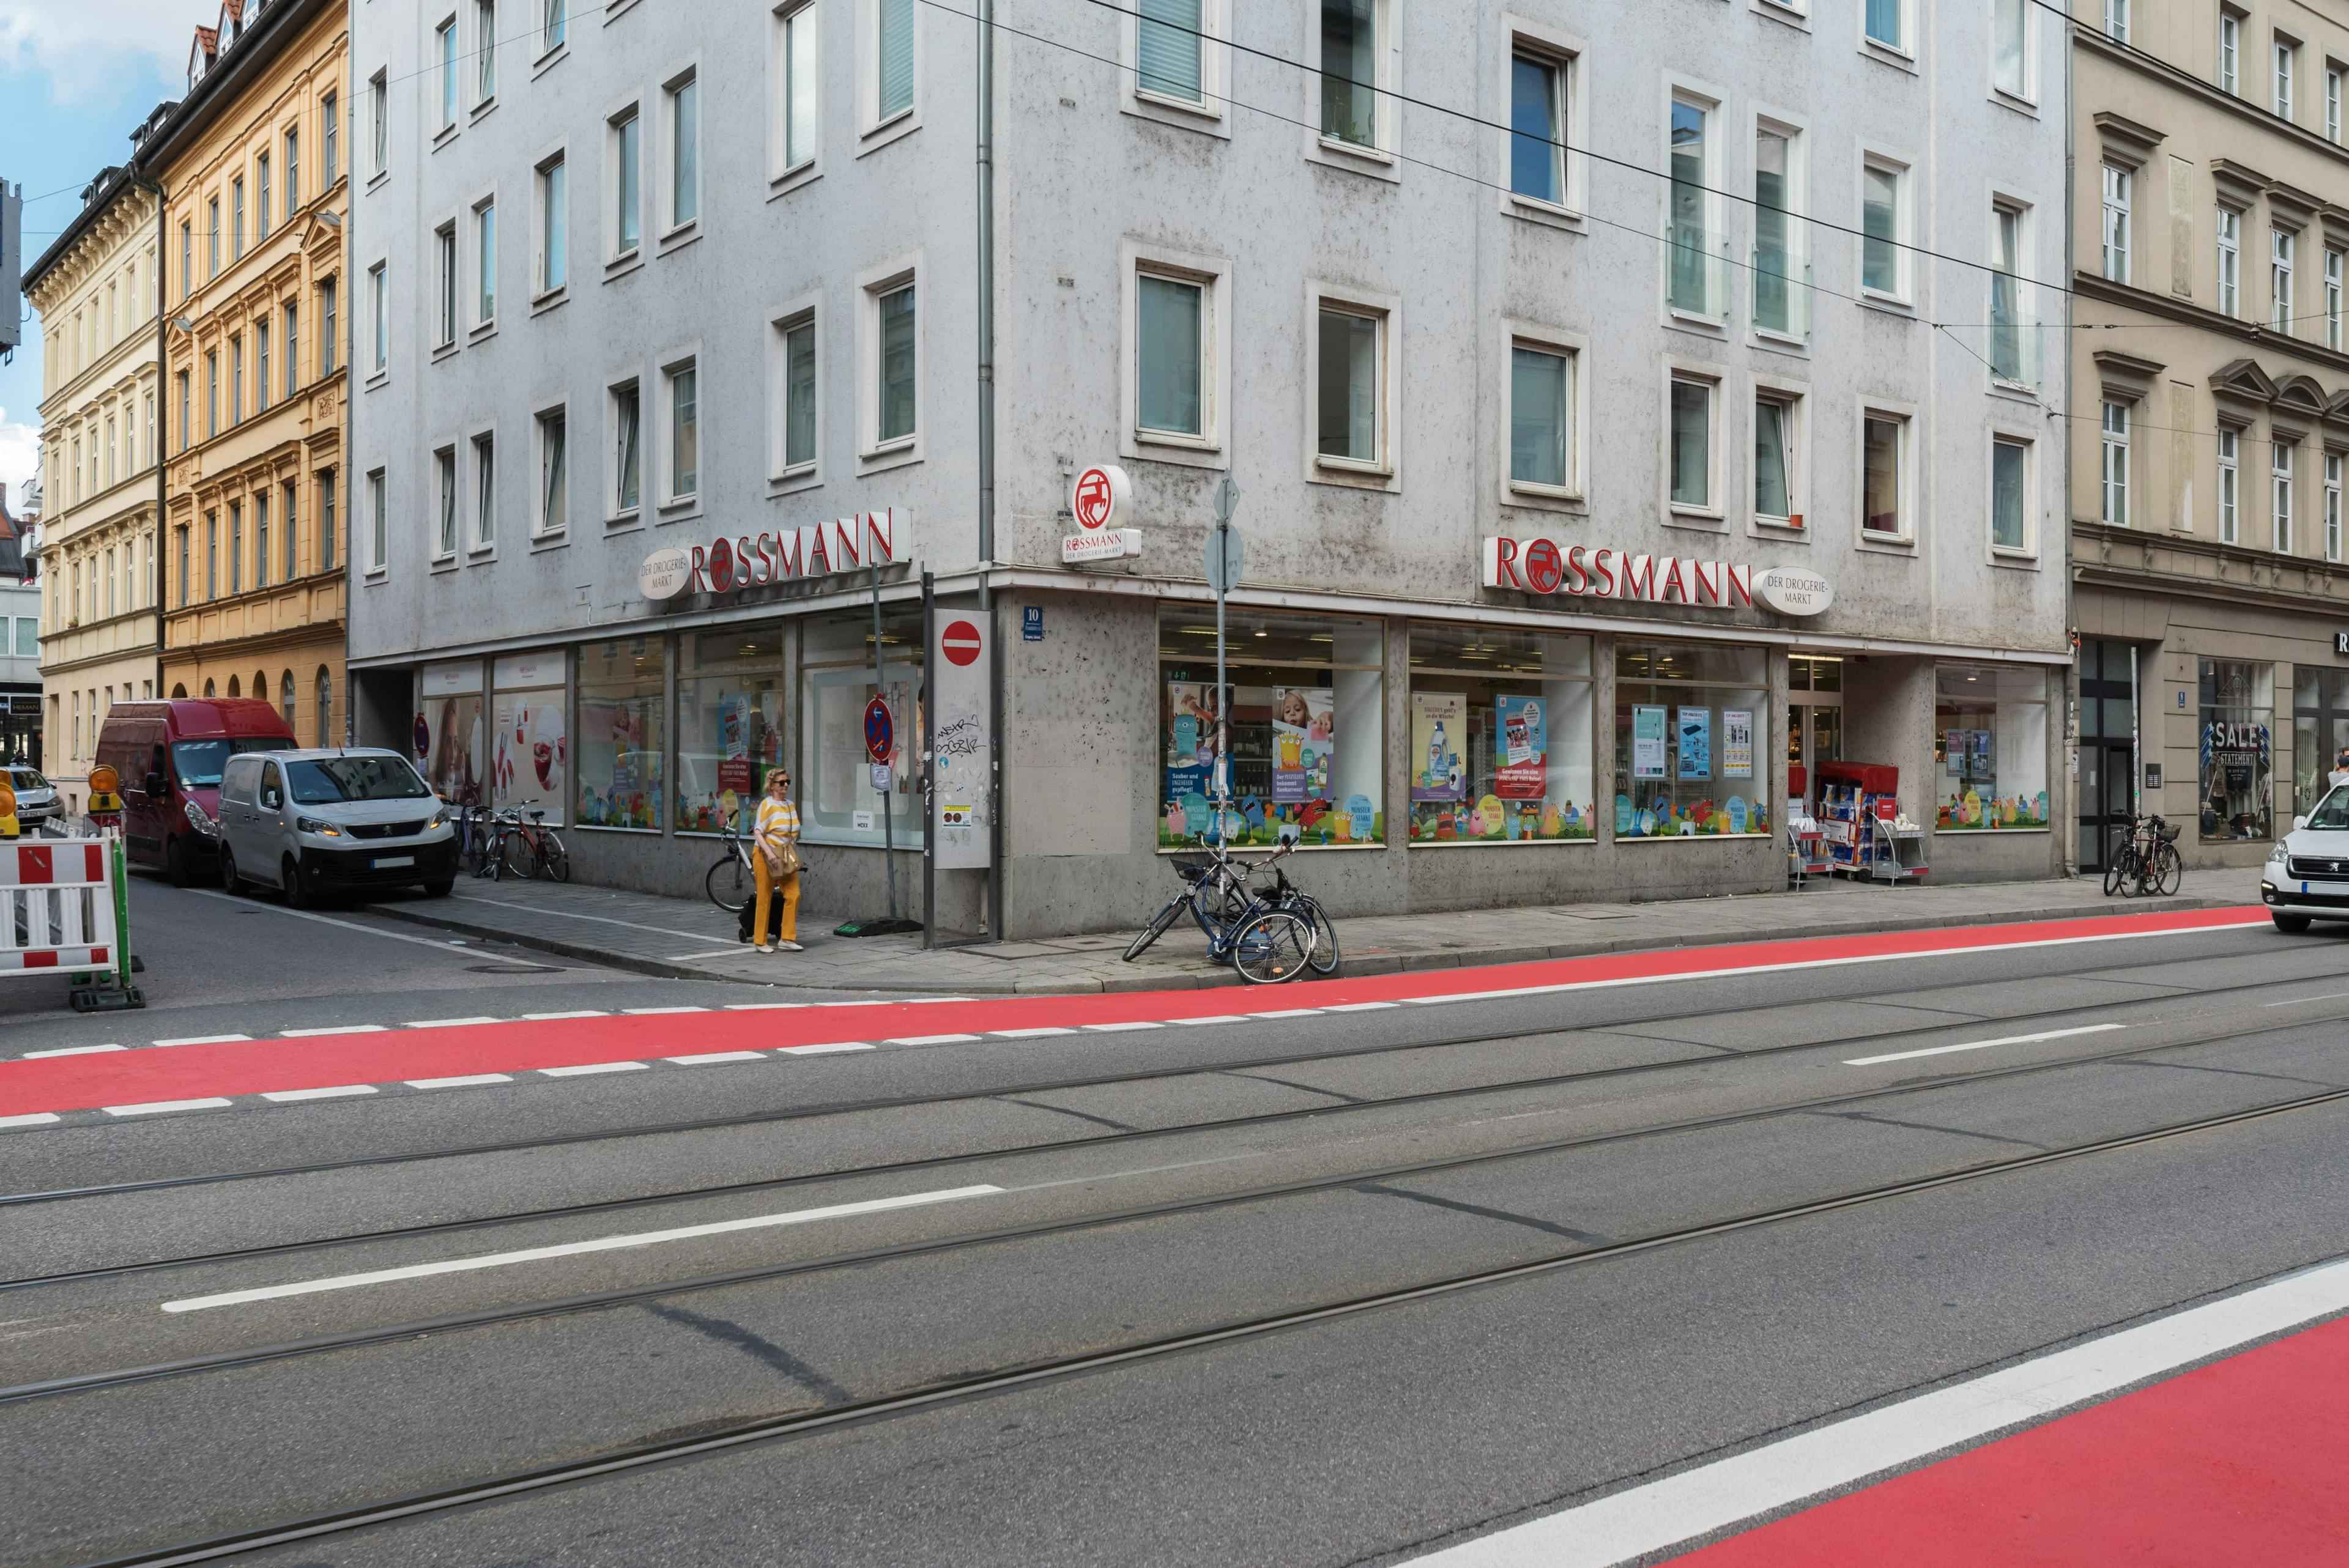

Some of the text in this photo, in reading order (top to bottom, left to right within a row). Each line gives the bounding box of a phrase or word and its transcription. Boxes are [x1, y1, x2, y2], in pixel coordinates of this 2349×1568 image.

[691, 507, 892, 594] ROSSMANN
[1066, 533, 1121, 551] ROSSMANN
[640, 557, 686, 577] DER DROGERIE-
[1497, 537, 1751, 607] ROSSMANN
[651, 574, 672, 588] MARKT
[1768, 576, 1828, 593] DER DROGERIE-
[1785, 592, 1811, 605] MARKT
[1028, 608, 1039, 621] 10
[2339, 633, 2349, 653] R
[2216, 722, 2257, 747] SALE
[2221, 753, 2253, 764] STATEMENT
